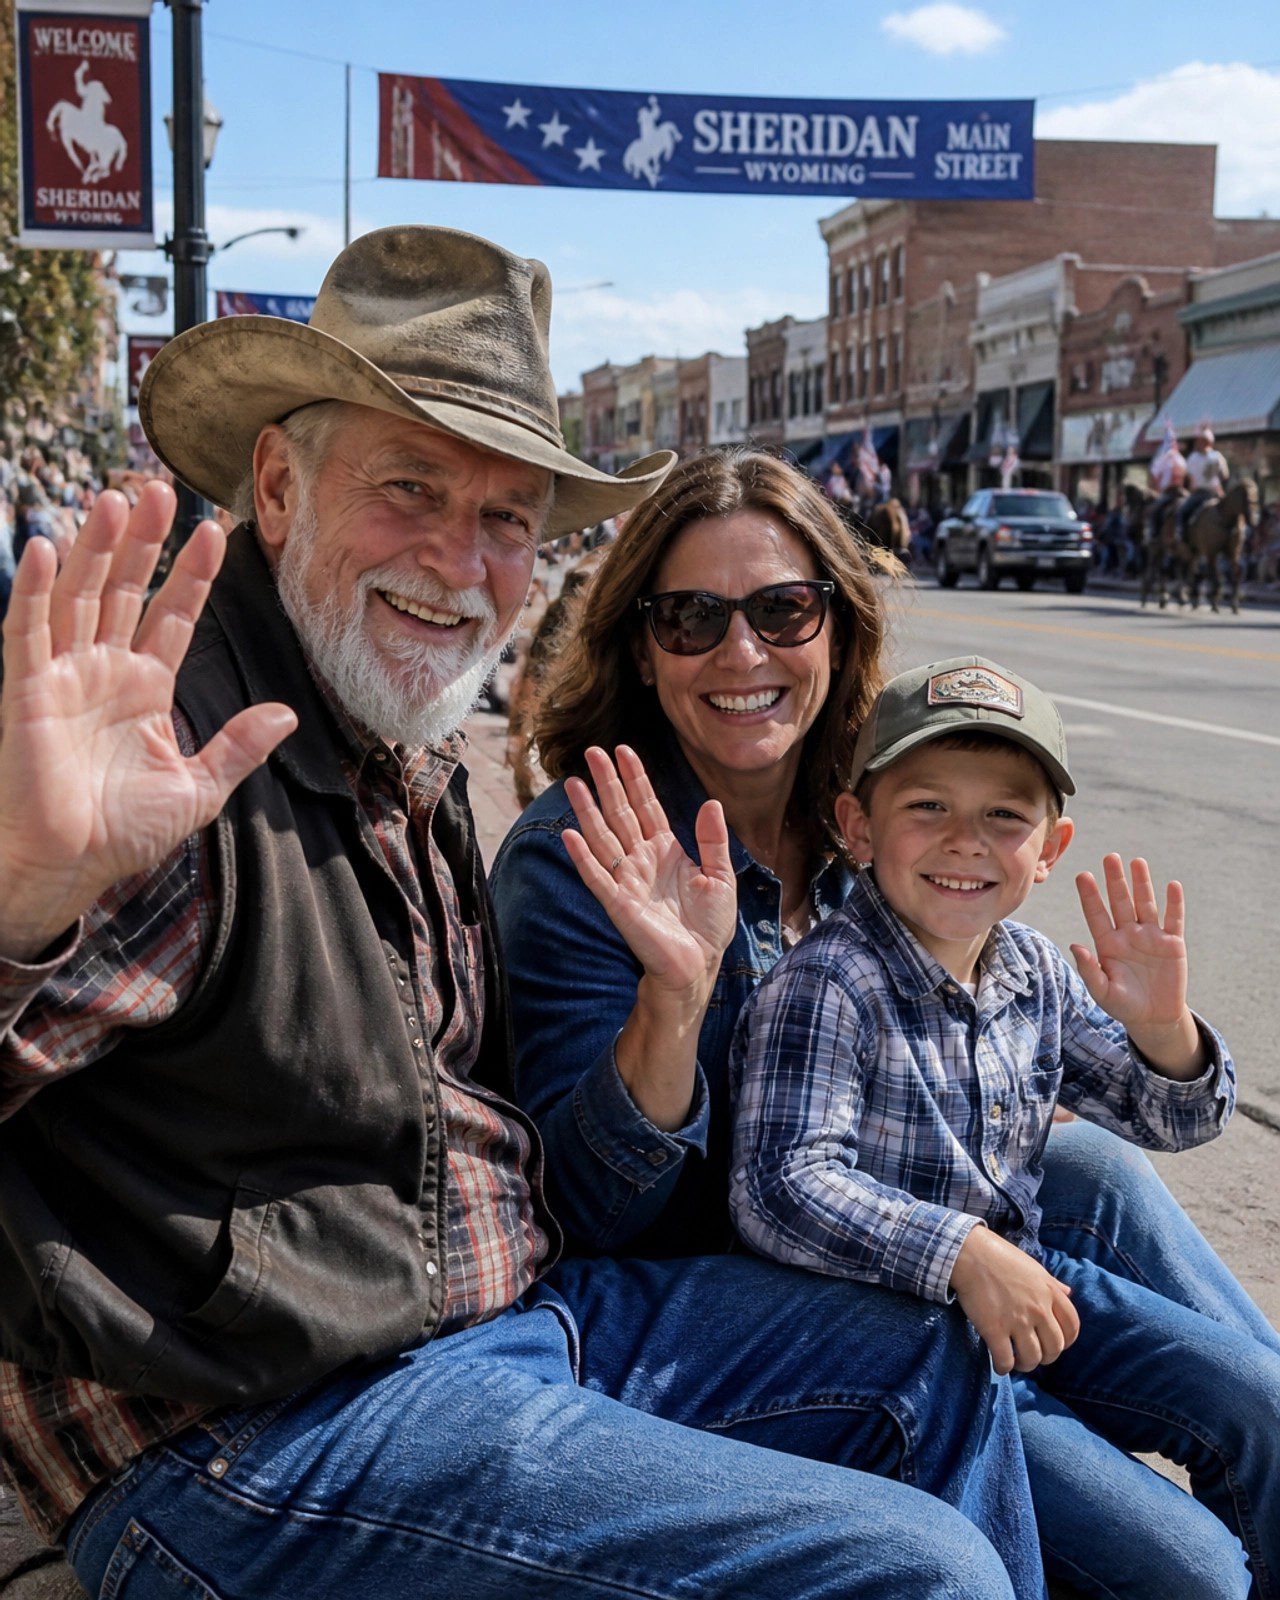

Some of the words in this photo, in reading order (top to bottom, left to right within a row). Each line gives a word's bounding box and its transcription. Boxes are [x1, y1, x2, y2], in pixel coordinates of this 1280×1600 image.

[33, 27, 137, 57] WELCOME
[693, 109, 919, 159] SHERIDAN
[946, 122, 1011, 151] MAIN
[744, 160, 866, 185] WYOMING
[934, 153, 1023, 181] STREET
[36, 187, 141, 210] SHERIDAN
